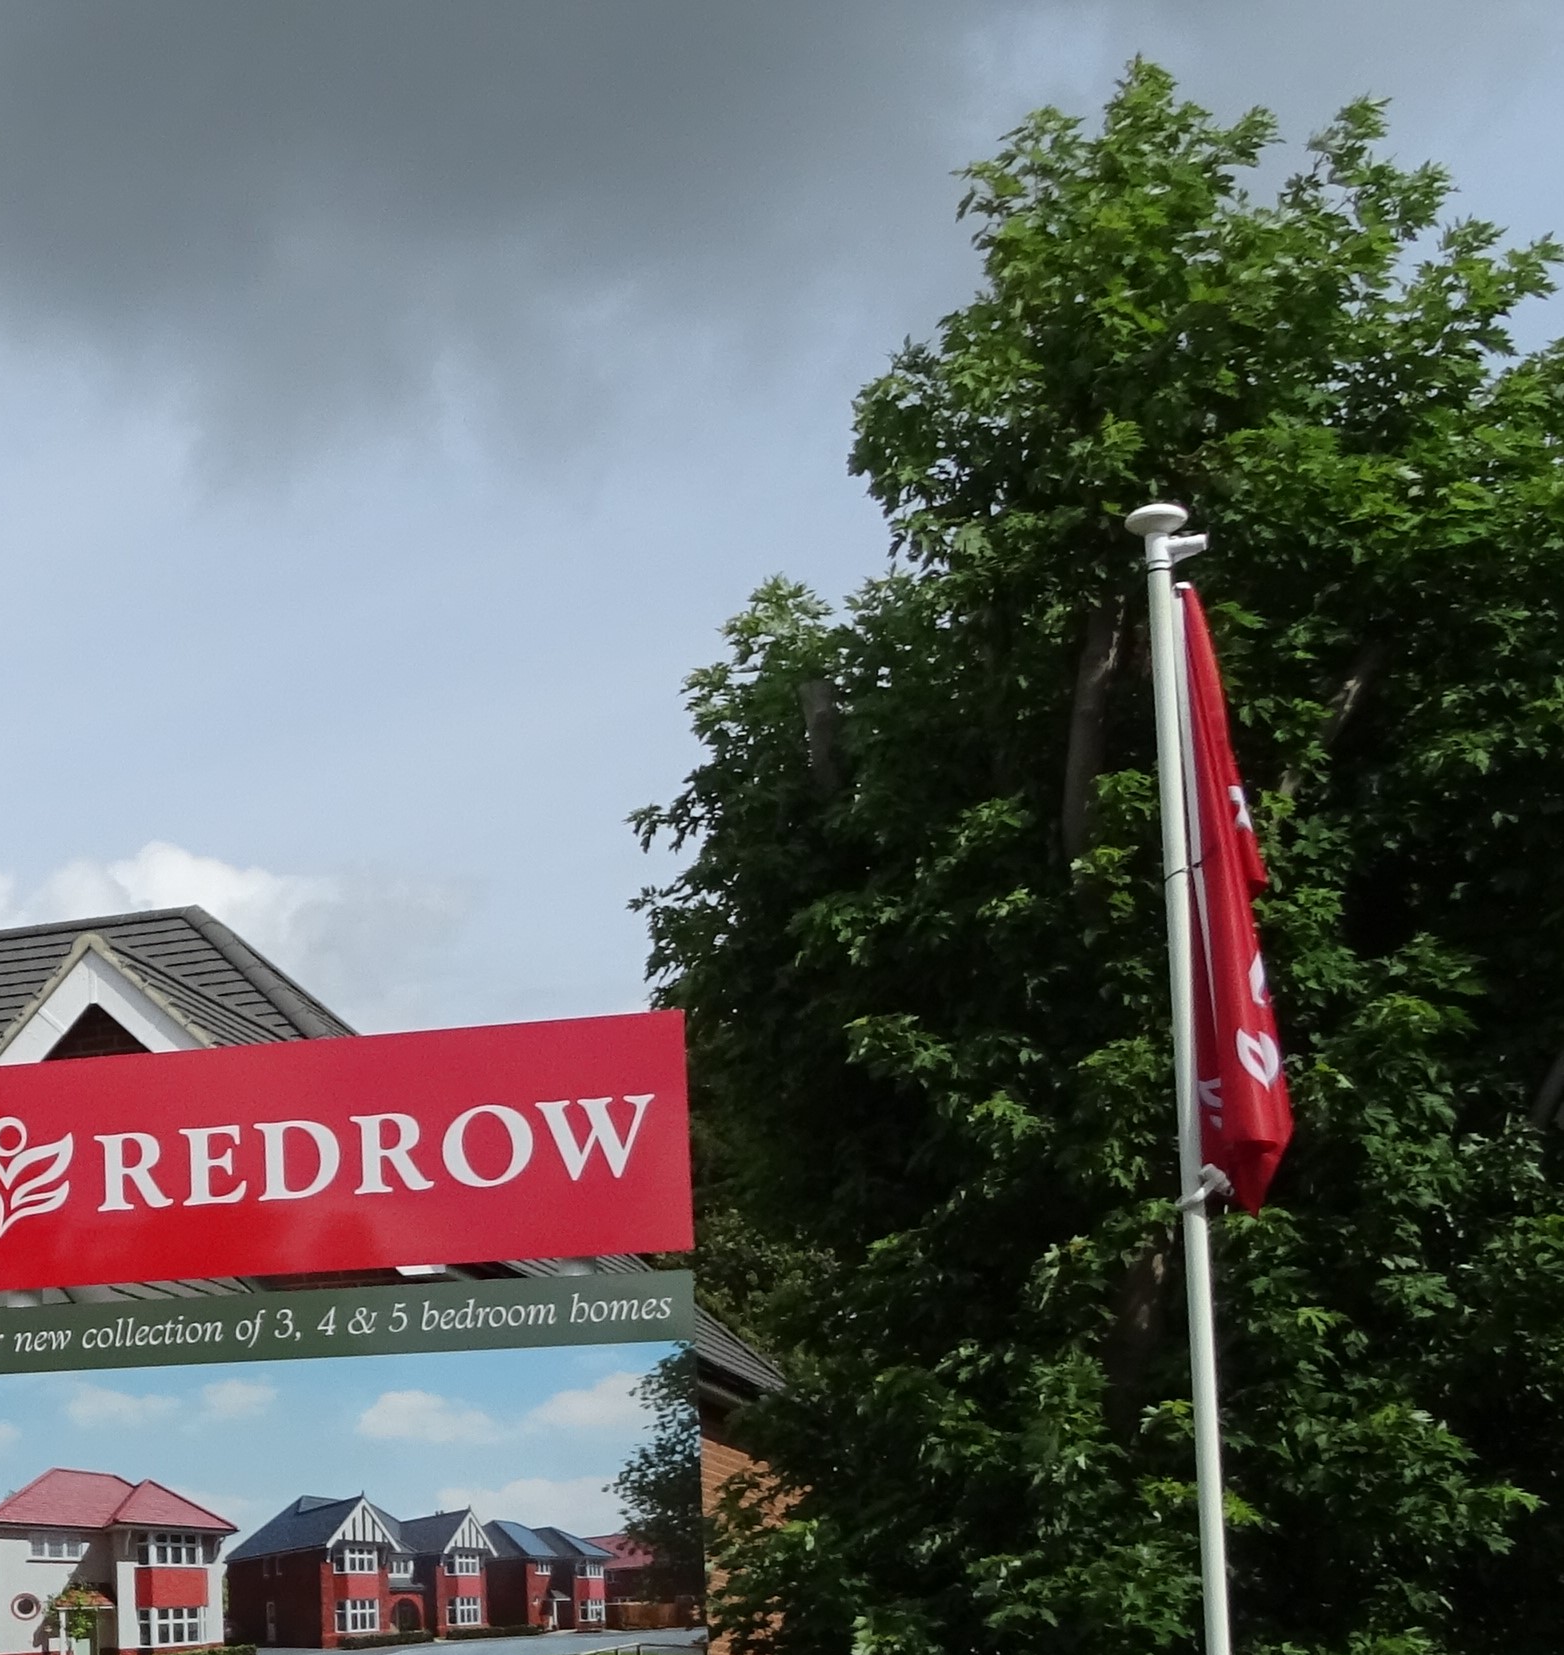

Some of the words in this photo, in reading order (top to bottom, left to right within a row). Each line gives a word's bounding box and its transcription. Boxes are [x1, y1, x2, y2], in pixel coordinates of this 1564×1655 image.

[94, 1093, 655, 1212] REDROW
[13, 1329, 72, 1354] new
[80, 1315, 224, 1349] collection
[234, 1308, 267, 1349] of
[273, 1308, 303, 1342] 3,
[316, 1306, 337, 1336] 4
[346, 1306, 377, 1336] &
[387, 1302, 409, 1334] 5
[421, 1298, 557, 1332] bedroom
[568, 1292, 673, 1324] homes
